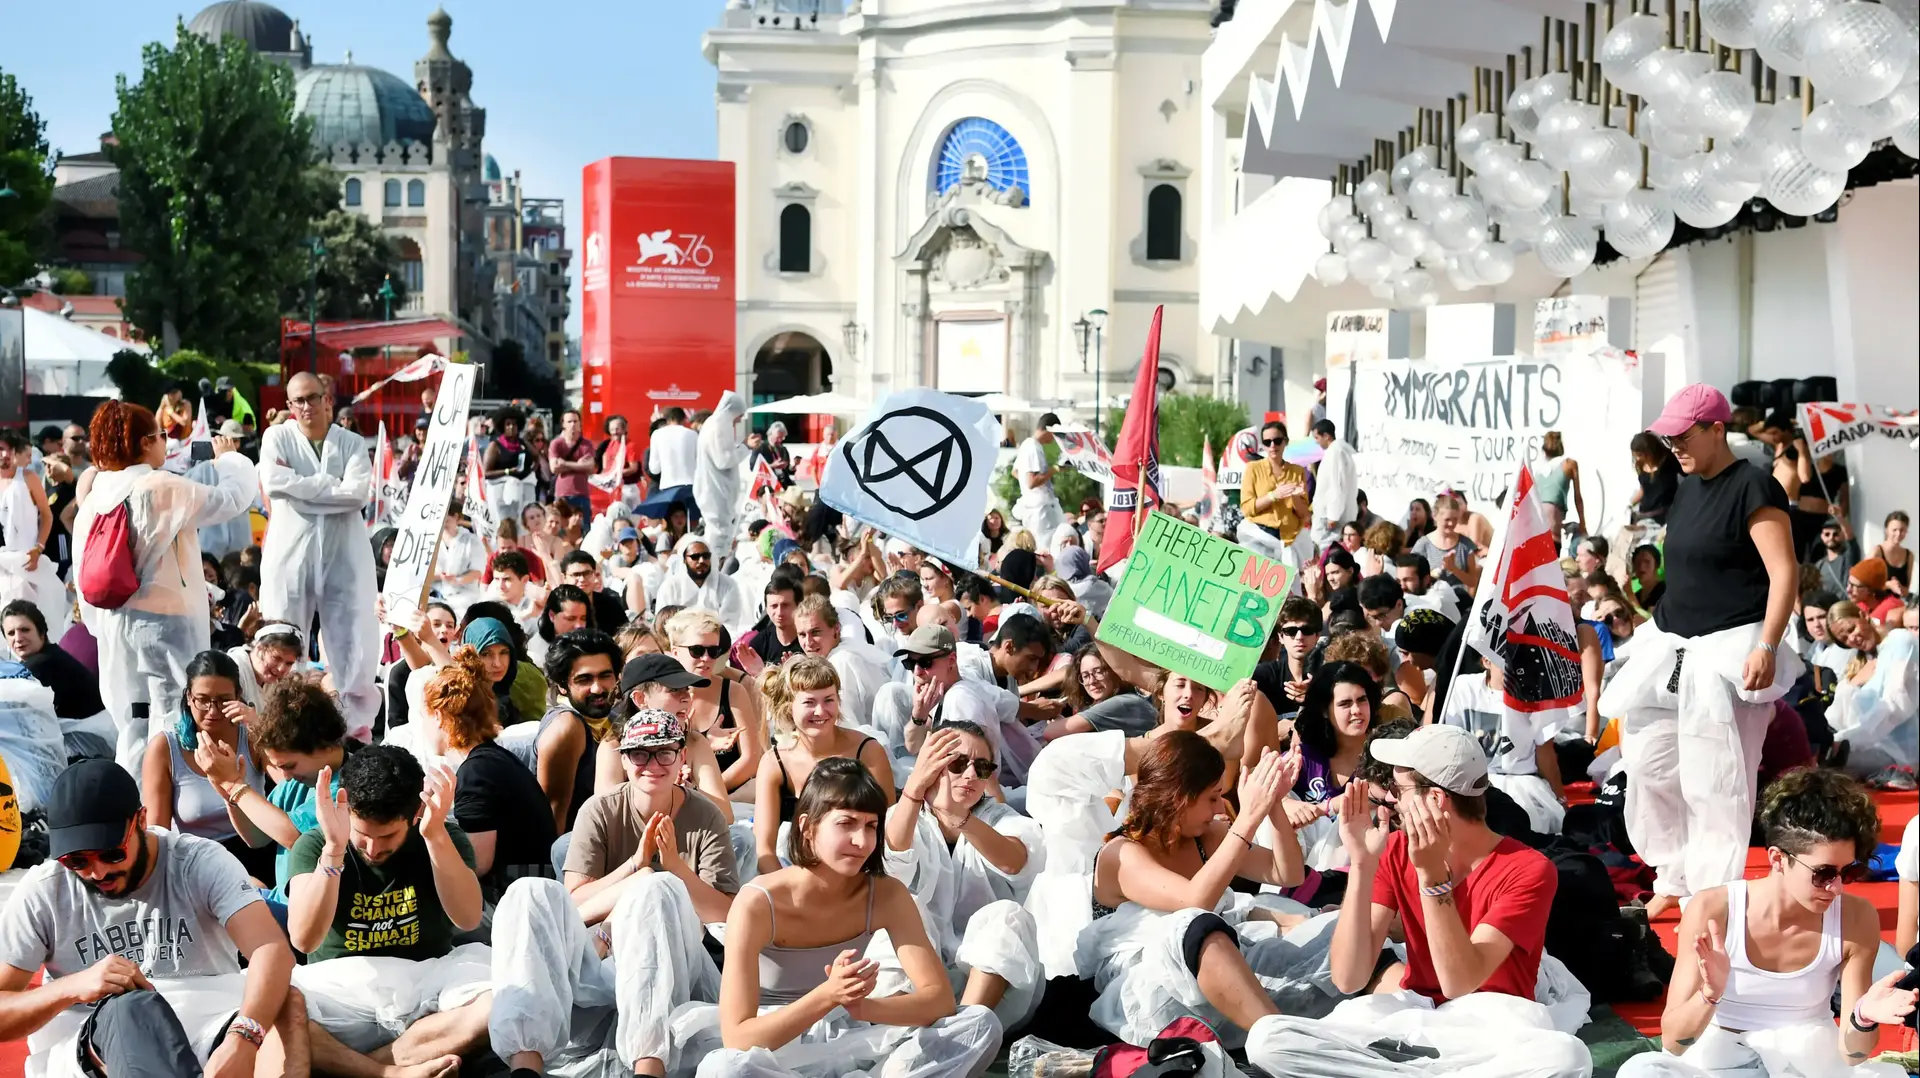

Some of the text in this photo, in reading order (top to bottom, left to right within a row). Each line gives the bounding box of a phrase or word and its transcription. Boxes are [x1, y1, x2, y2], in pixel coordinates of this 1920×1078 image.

[678, 233, 714, 267] 76
[1383, 363, 1562, 430] IMMIGRANTS
[1471, 435, 1546, 463] TOURS
[1146, 513, 1287, 598] THERE IS NO
[1118, 549, 1270, 649] PLANET B
[1107, 621, 1233, 682] #FRIDAYSFORFUTURE
[350, 898, 418, 921] CHANGE
[352, 885, 417, 907] SYSTEM
[345, 920, 420, 943] CLIMATE
[371, 918, 394, 931] not
